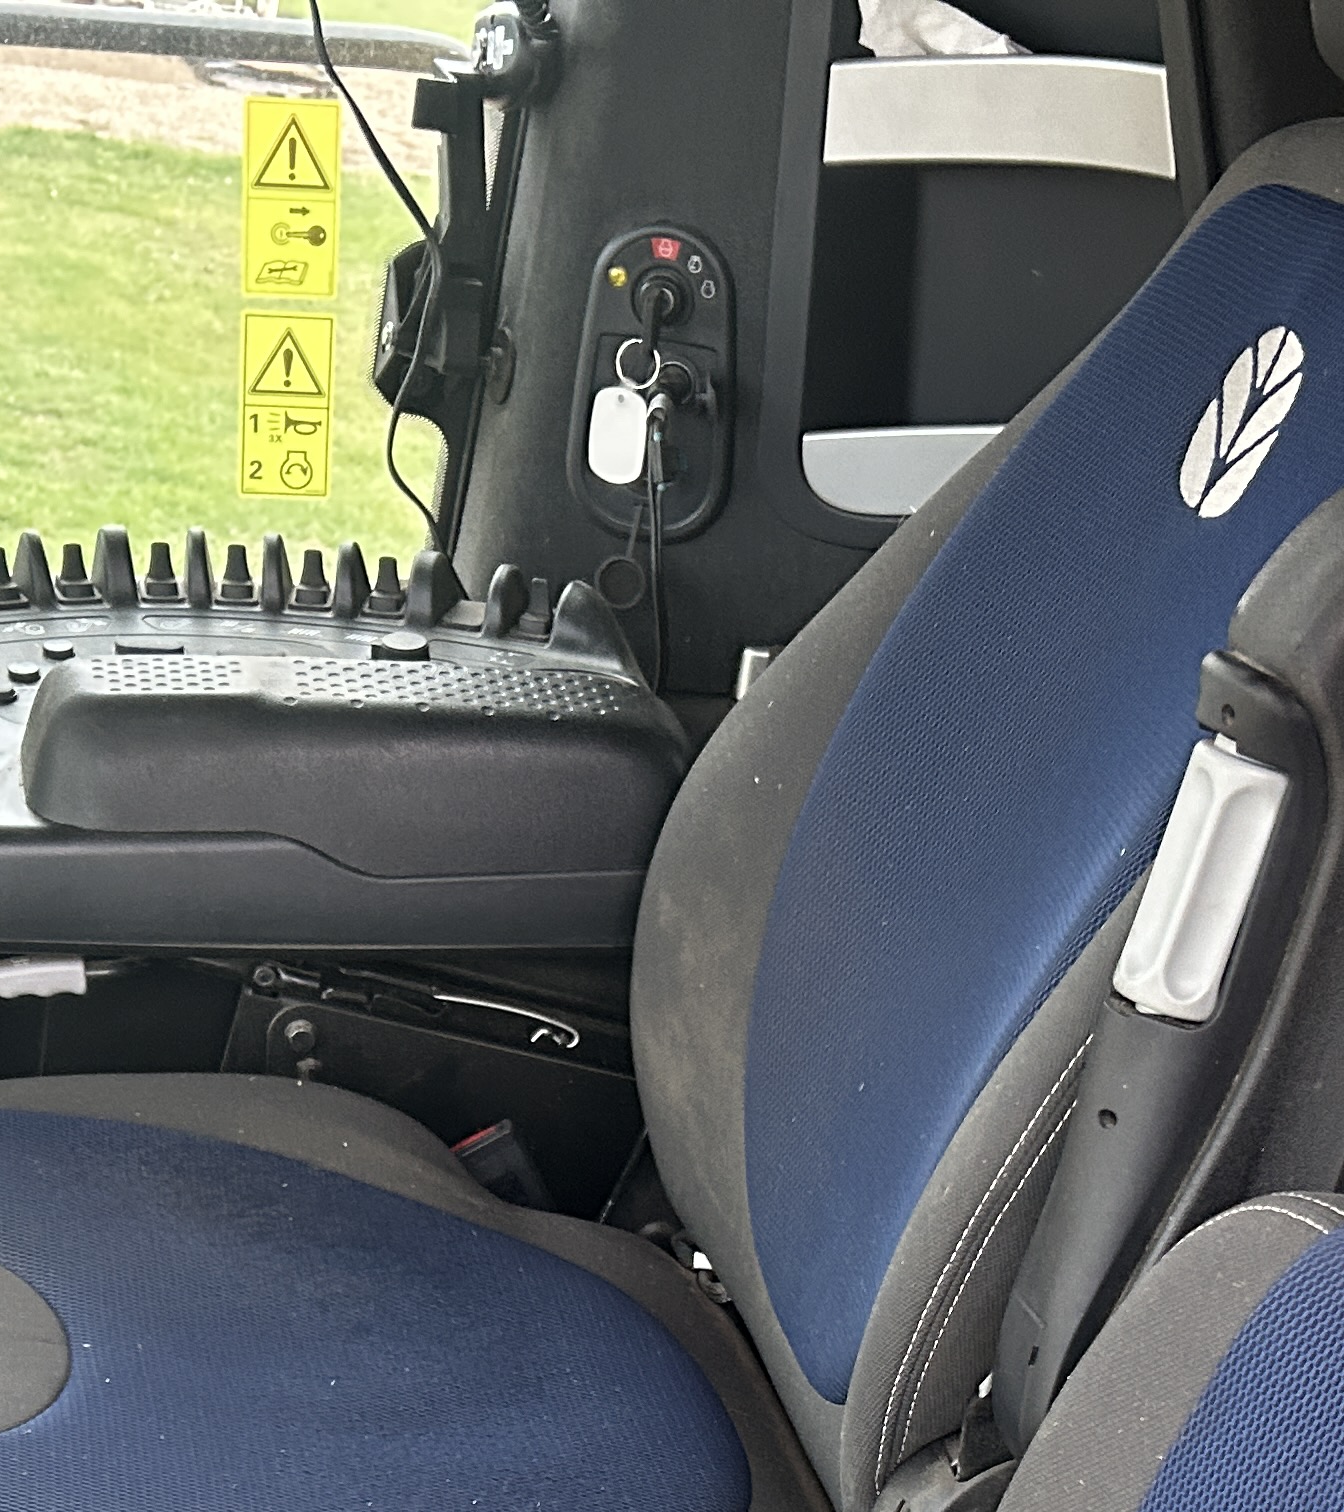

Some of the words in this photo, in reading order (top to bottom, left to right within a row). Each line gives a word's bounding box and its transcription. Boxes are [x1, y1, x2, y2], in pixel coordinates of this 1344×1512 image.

[249, 413, 259, 434] 1
[268, 434, 282, 443] 3X
[249, 459, 263, 480] 2
